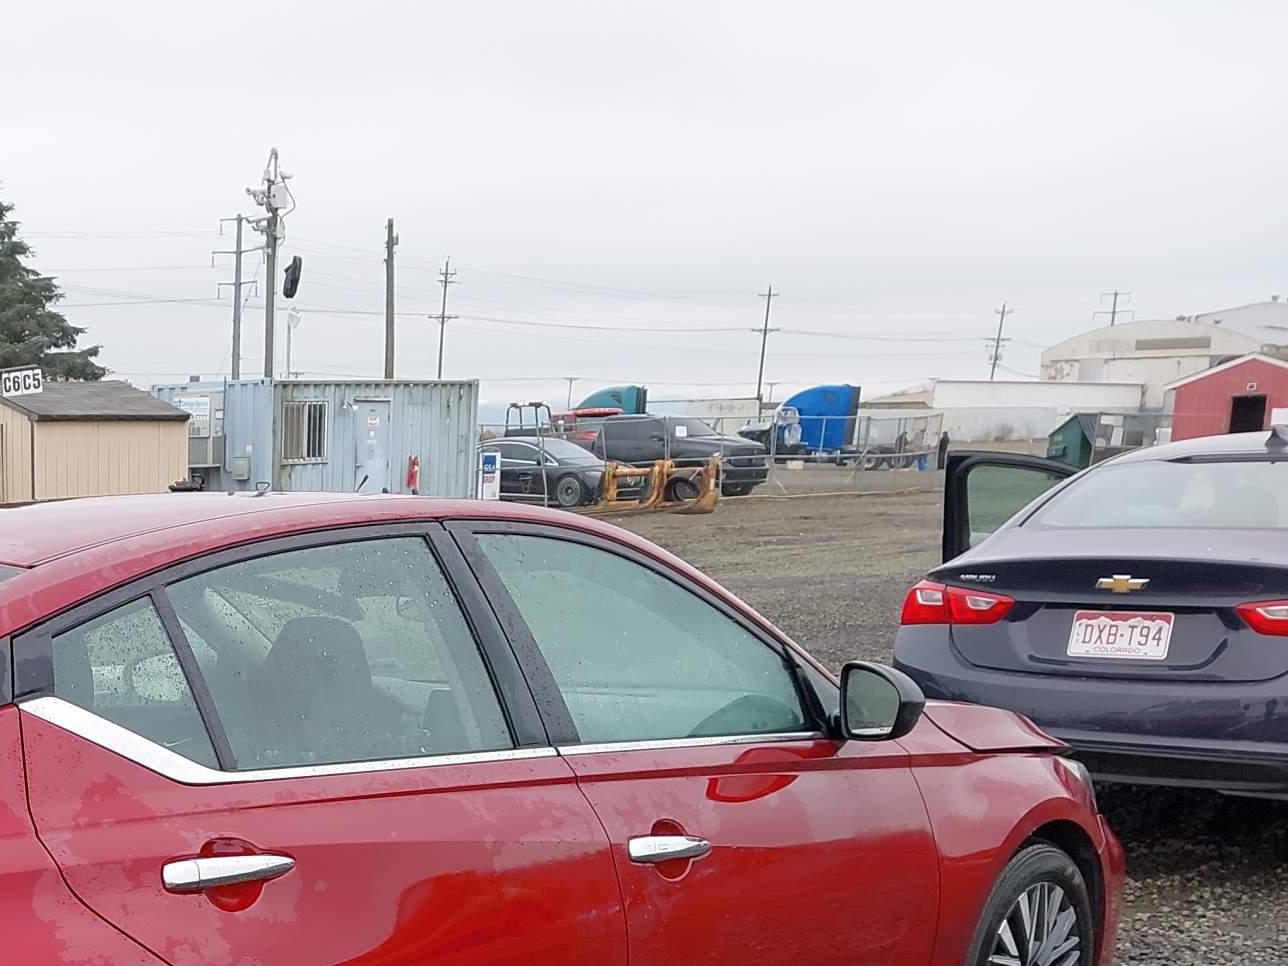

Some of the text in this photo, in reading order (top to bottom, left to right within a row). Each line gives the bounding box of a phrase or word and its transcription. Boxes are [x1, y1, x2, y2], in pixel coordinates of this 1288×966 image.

[3, 373, 41, 393] C6 C5
[1093, 645, 1142, 655] COLORADO
